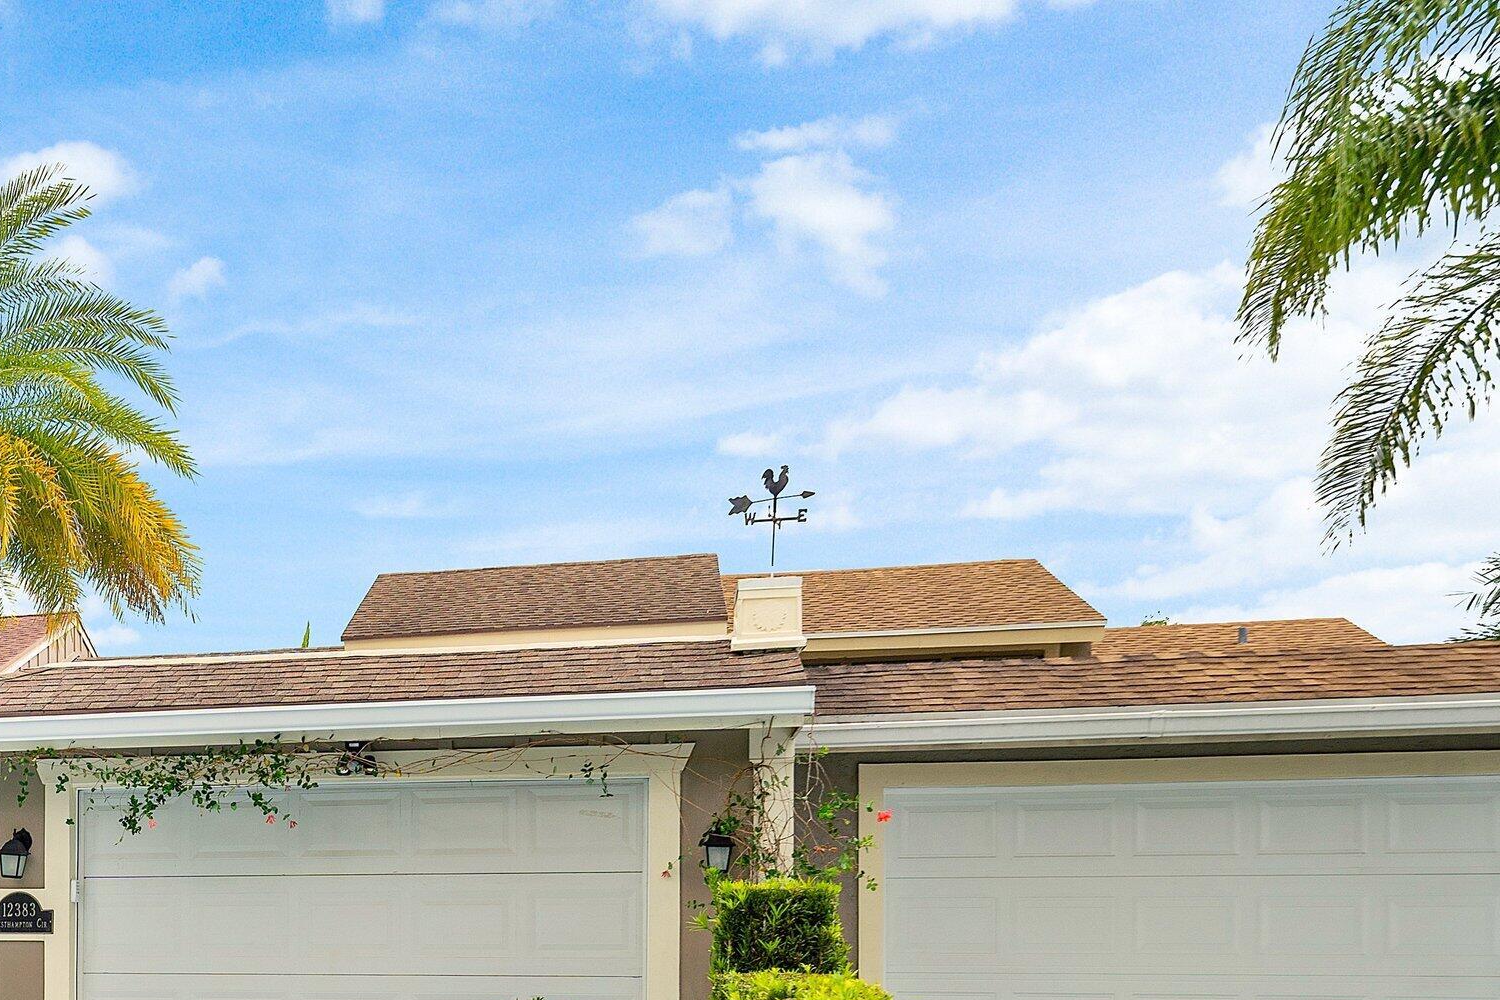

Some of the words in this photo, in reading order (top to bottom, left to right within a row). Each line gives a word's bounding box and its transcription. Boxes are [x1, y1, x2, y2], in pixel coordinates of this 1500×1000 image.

[744, 512, 756, 525] W
[797, 508, 808, 522] E
[2, 902, 36, 917] 12383
